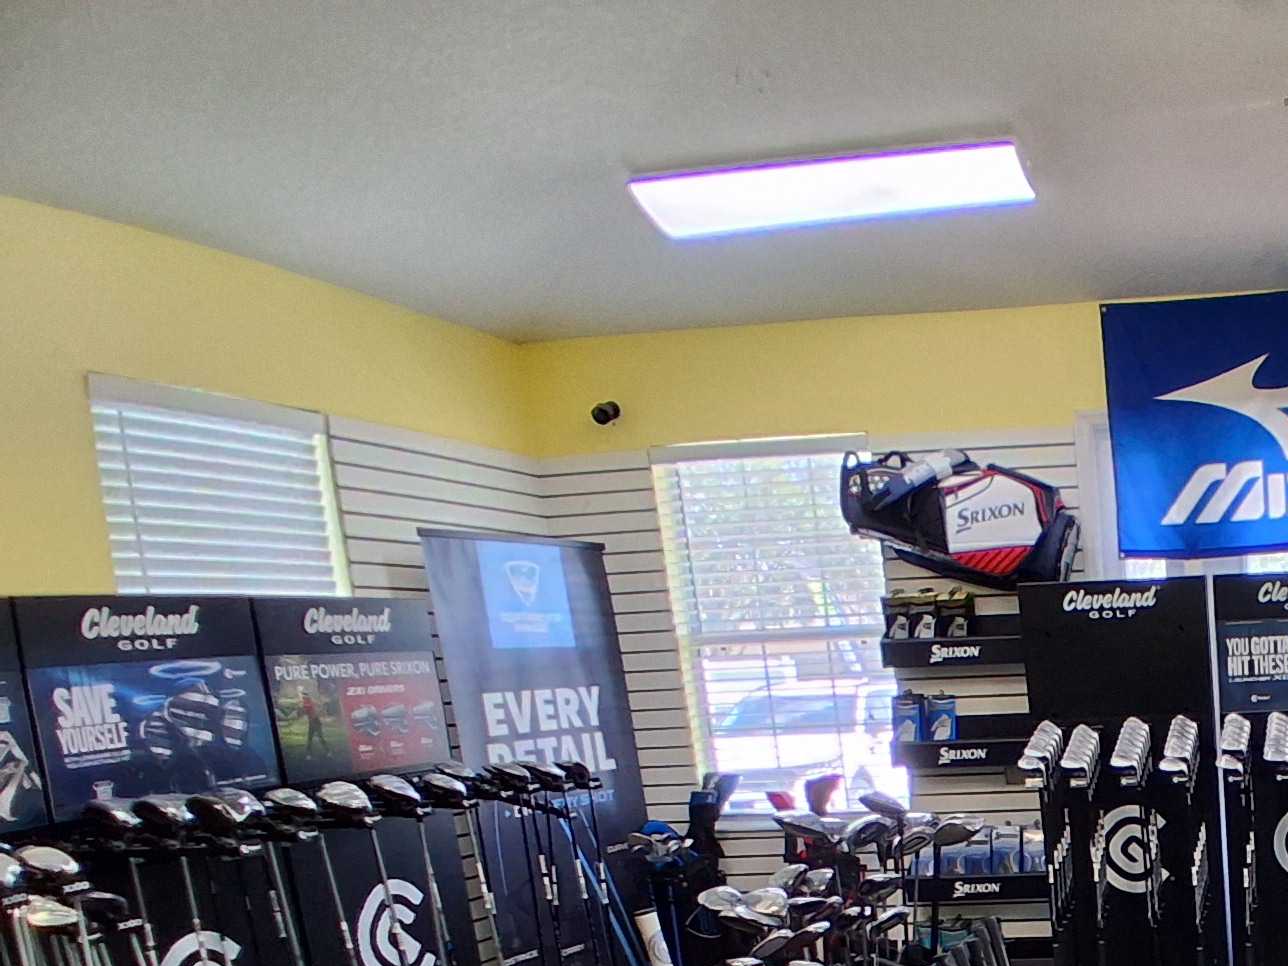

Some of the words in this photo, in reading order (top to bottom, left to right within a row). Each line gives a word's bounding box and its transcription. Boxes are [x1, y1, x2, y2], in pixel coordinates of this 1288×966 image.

[955, 501, 1025, 534] SRIXON
[1062, 585, 1157, 612] Cleveland
[80, 605, 200, 640] Cleveland
[304, 607, 392, 634] Cleveland
[1089, 609, 1137, 619] GOLF
[117, 638, 180, 650] GOLF
[331, 635, 377, 645] GOLF
[1226, 637, 1250, 655] YOU
[929, 644, 982, 664] SRIXON
[274, 665, 310, 681] PURE
[310, 663, 359, 679] POWER,
[359, 661, 390, 677] PURE
[390, 660, 431, 675] SRIXON
[1227, 656, 1250, 677] HIT
[52, 684, 121, 727] SAVE
[481, 686, 601, 737] EVERY
[57, 722, 129, 755] YOURSELF
[938, 746, 988, 765] SRIXON
[952, 880, 1001, 898] SRIXON
